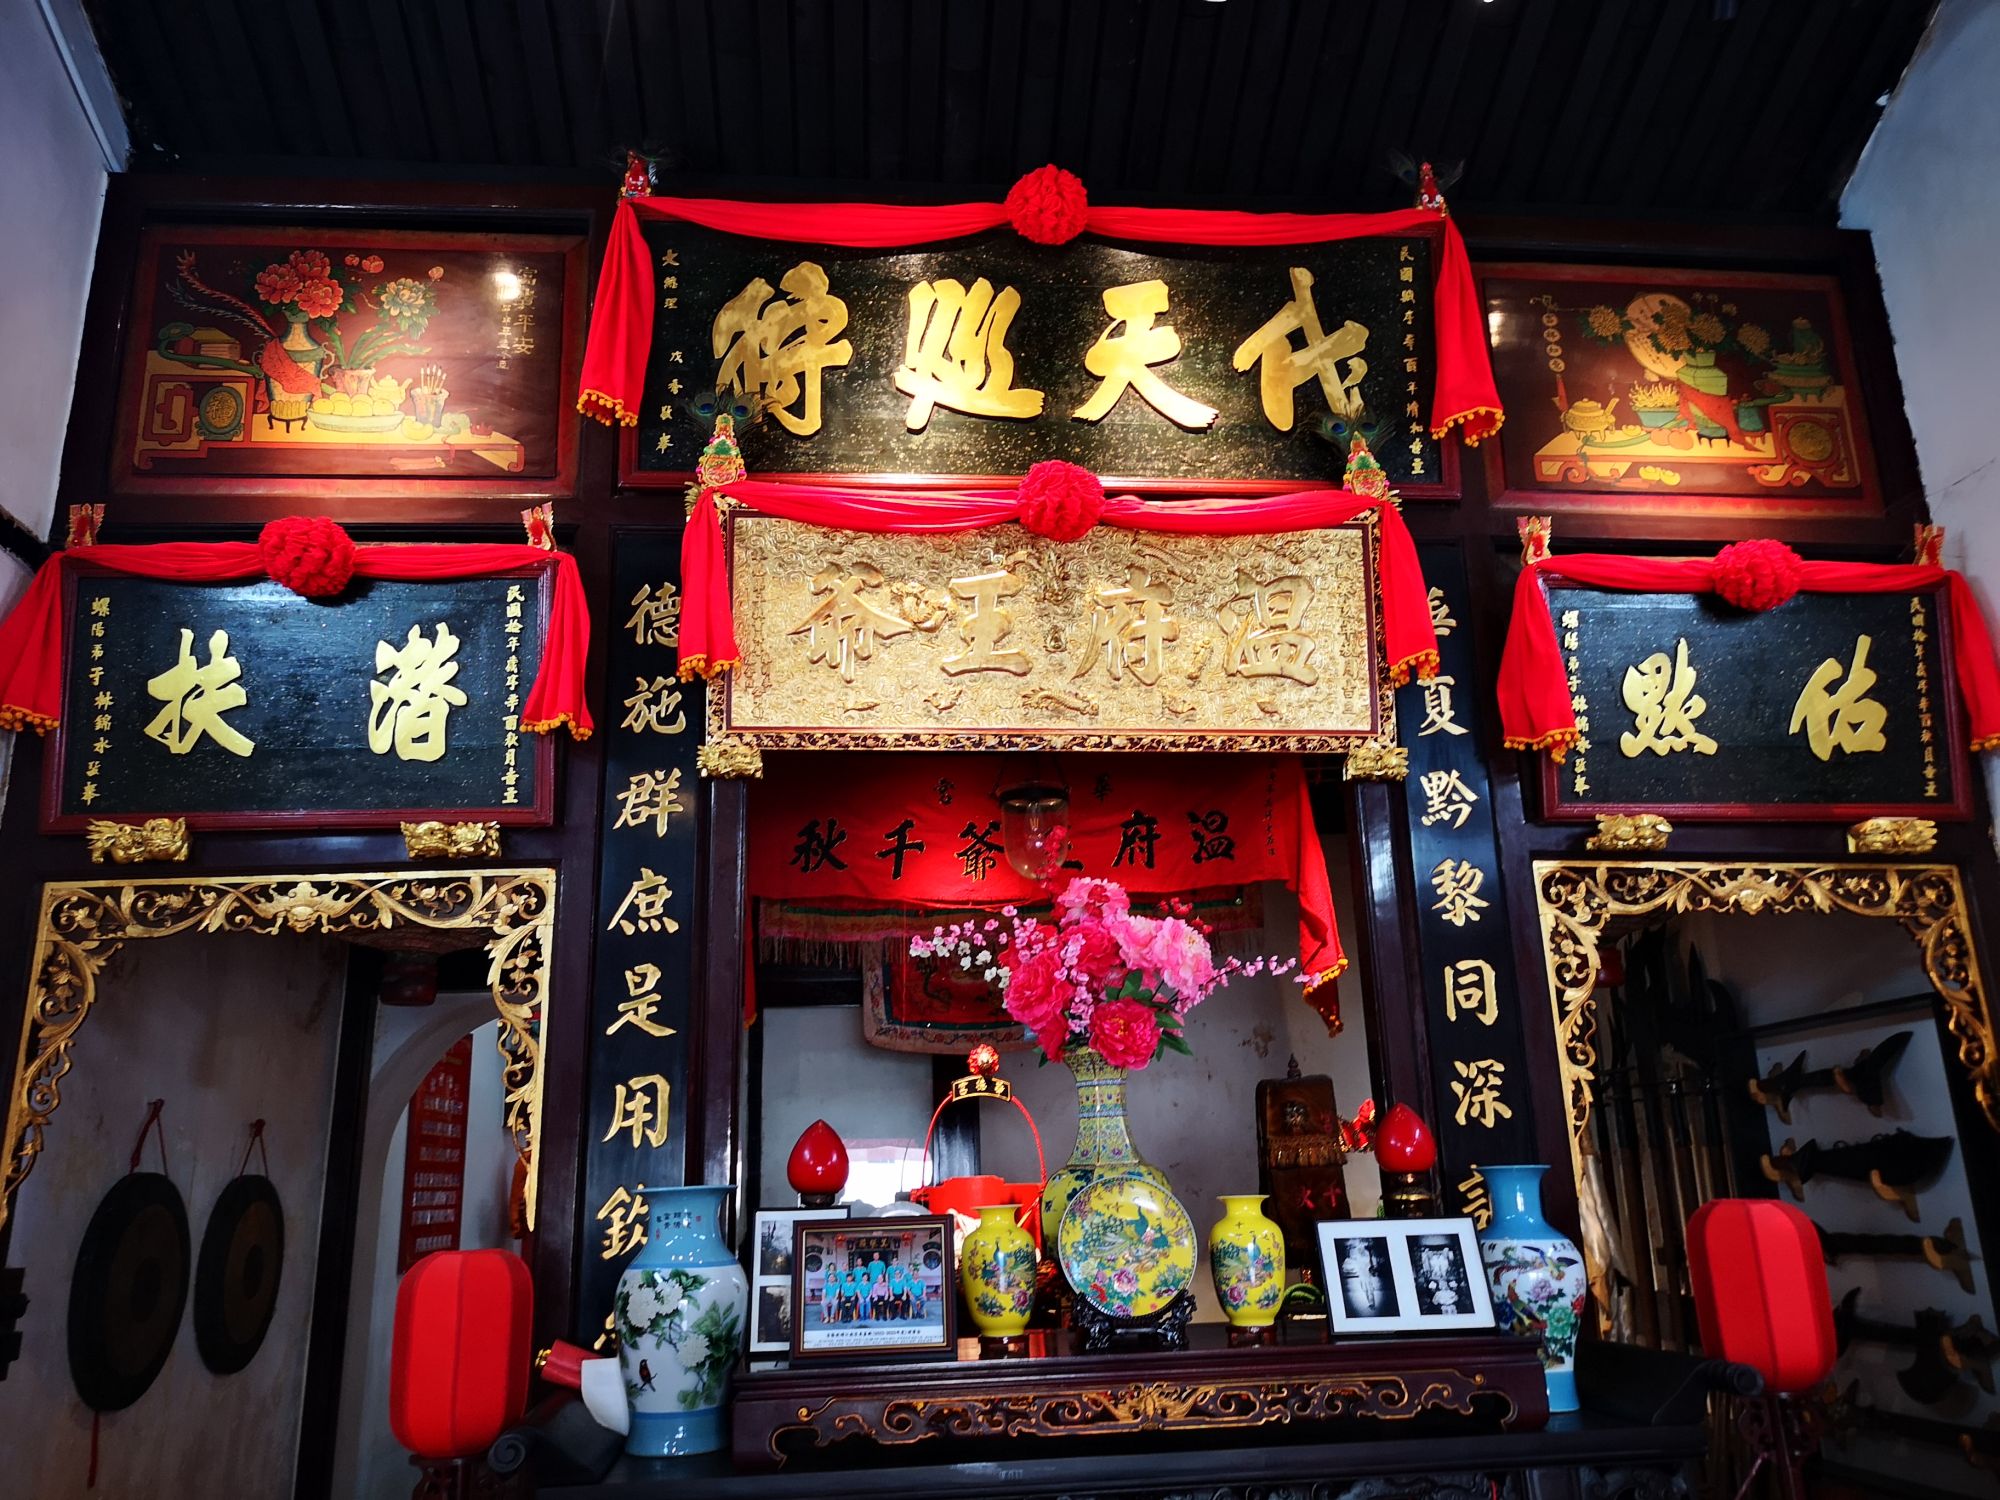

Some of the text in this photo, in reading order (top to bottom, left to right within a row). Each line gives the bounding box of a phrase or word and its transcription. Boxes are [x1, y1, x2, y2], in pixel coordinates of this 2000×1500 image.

[594, 582, 687, 1350] 德施群庶是用欽
